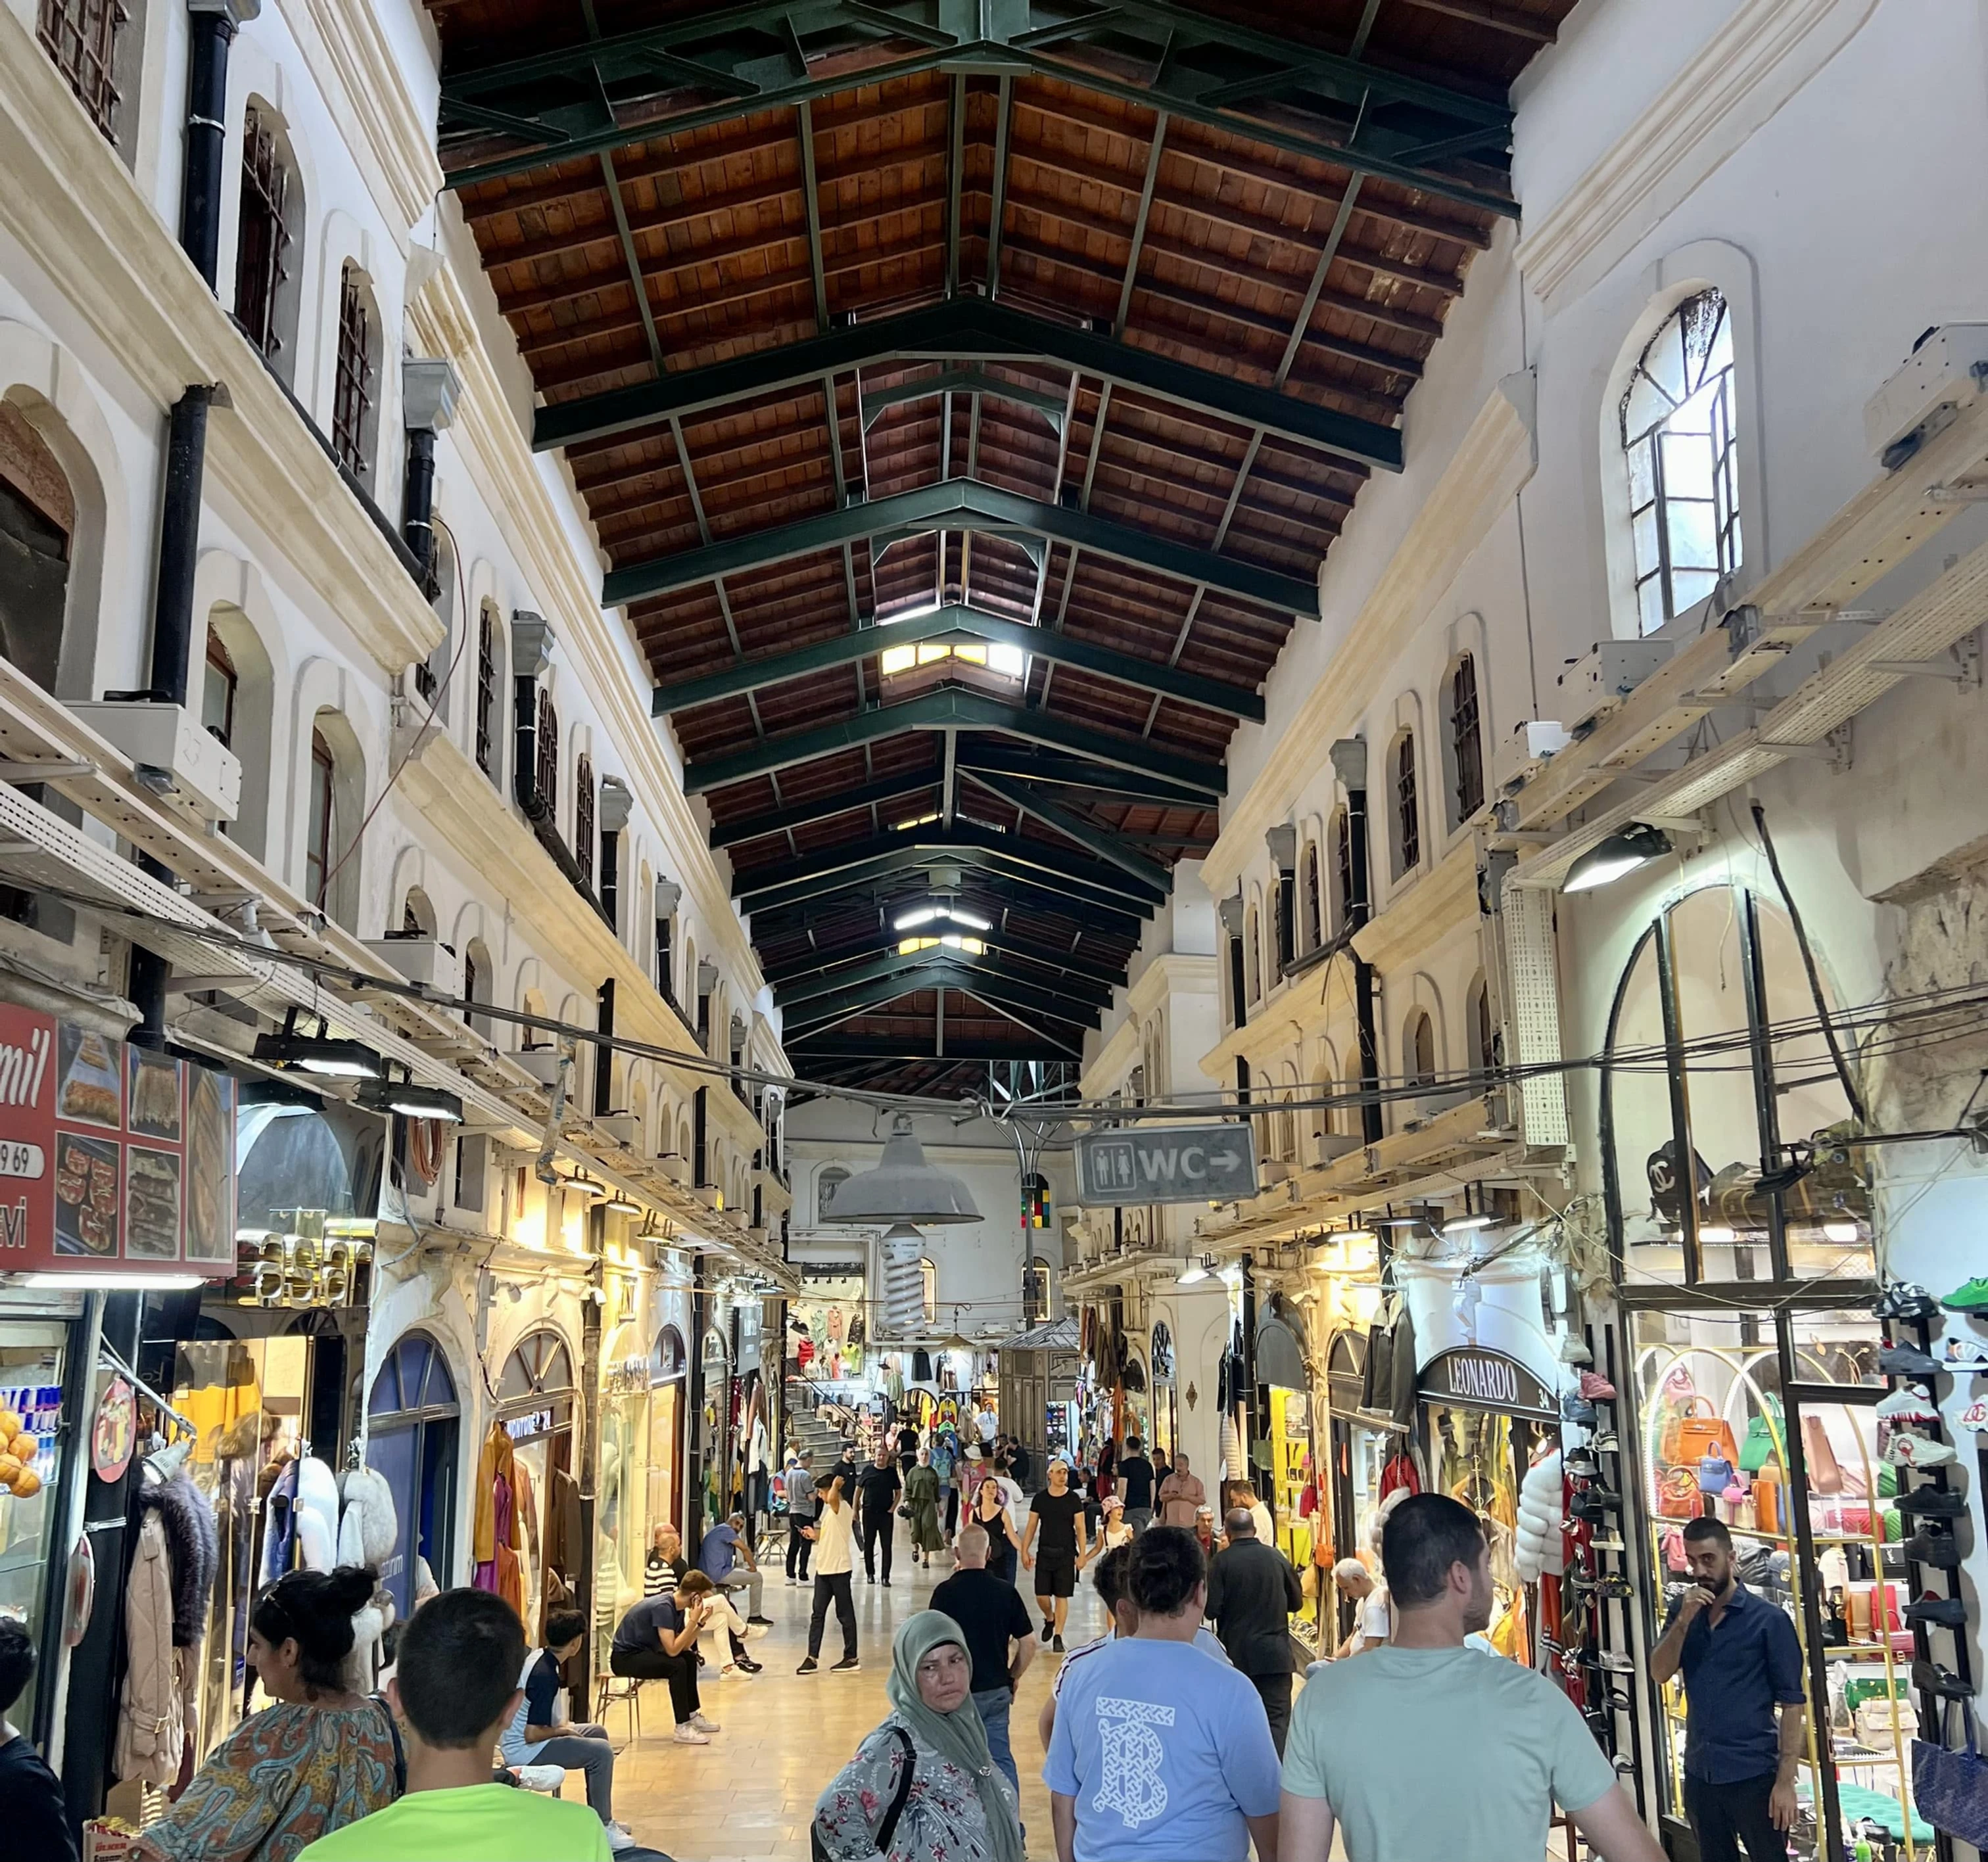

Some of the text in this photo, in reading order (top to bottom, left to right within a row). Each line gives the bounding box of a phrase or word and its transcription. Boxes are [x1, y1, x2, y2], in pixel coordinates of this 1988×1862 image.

[13, 1146, 29, 1173] 69
[1138, 1147, 1206, 1181] WC
[1447, 1356, 1518, 1403] LEONARDO
